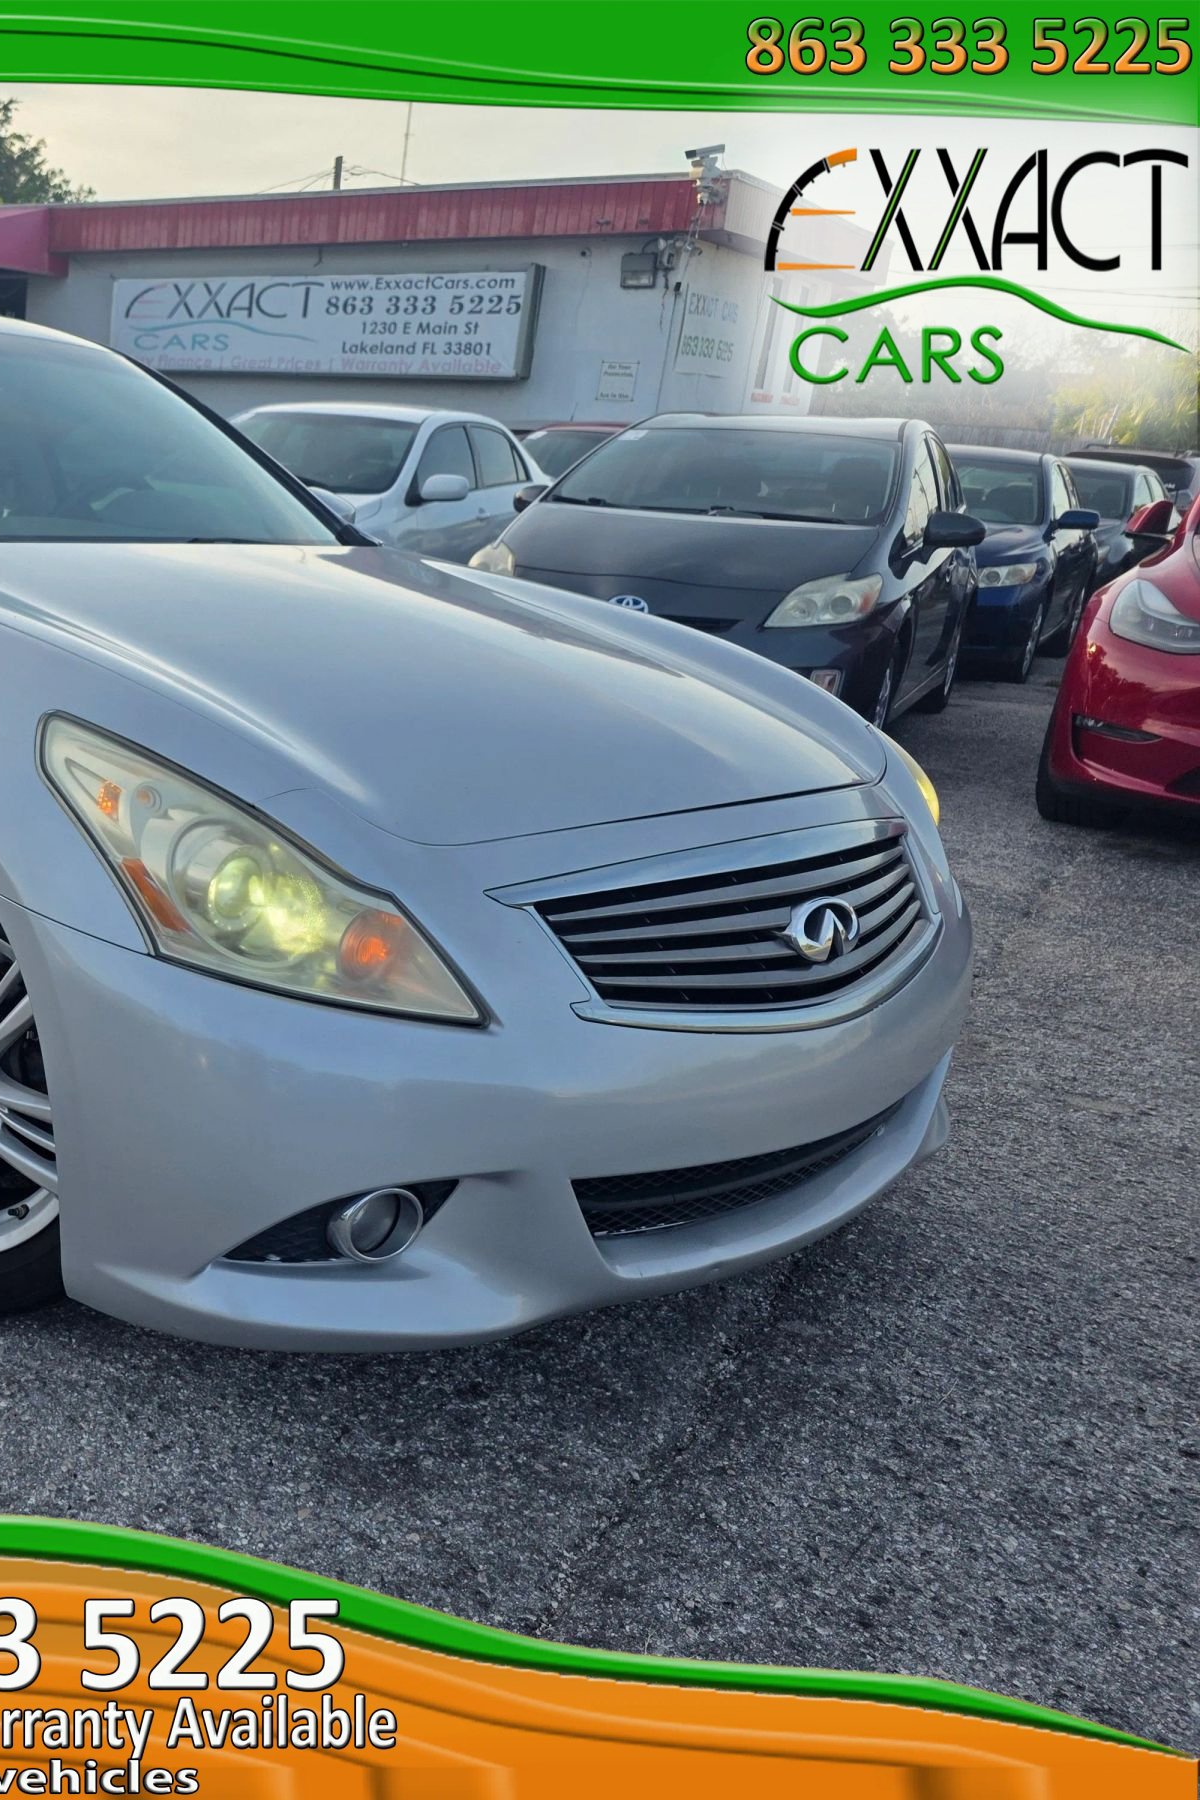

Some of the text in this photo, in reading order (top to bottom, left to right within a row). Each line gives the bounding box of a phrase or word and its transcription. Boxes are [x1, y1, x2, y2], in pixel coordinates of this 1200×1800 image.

[330, 276, 516, 291] www.ExxactCars.com
[125, 281, 325, 319] EXXACT
[325, 294, 522, 316] 863 333 5225
[361, 321, 480, 336] 1230 E Main St
[133, 333, 230, 351] CARS
[341, 341, 492, 356] Lakeland FL 33801
[230, 354, 273, 370] Great
[276, 355, 321, 371] Prices
[341, 357, 413, 375] Warranty
[419, 358, 501, 375] Available
